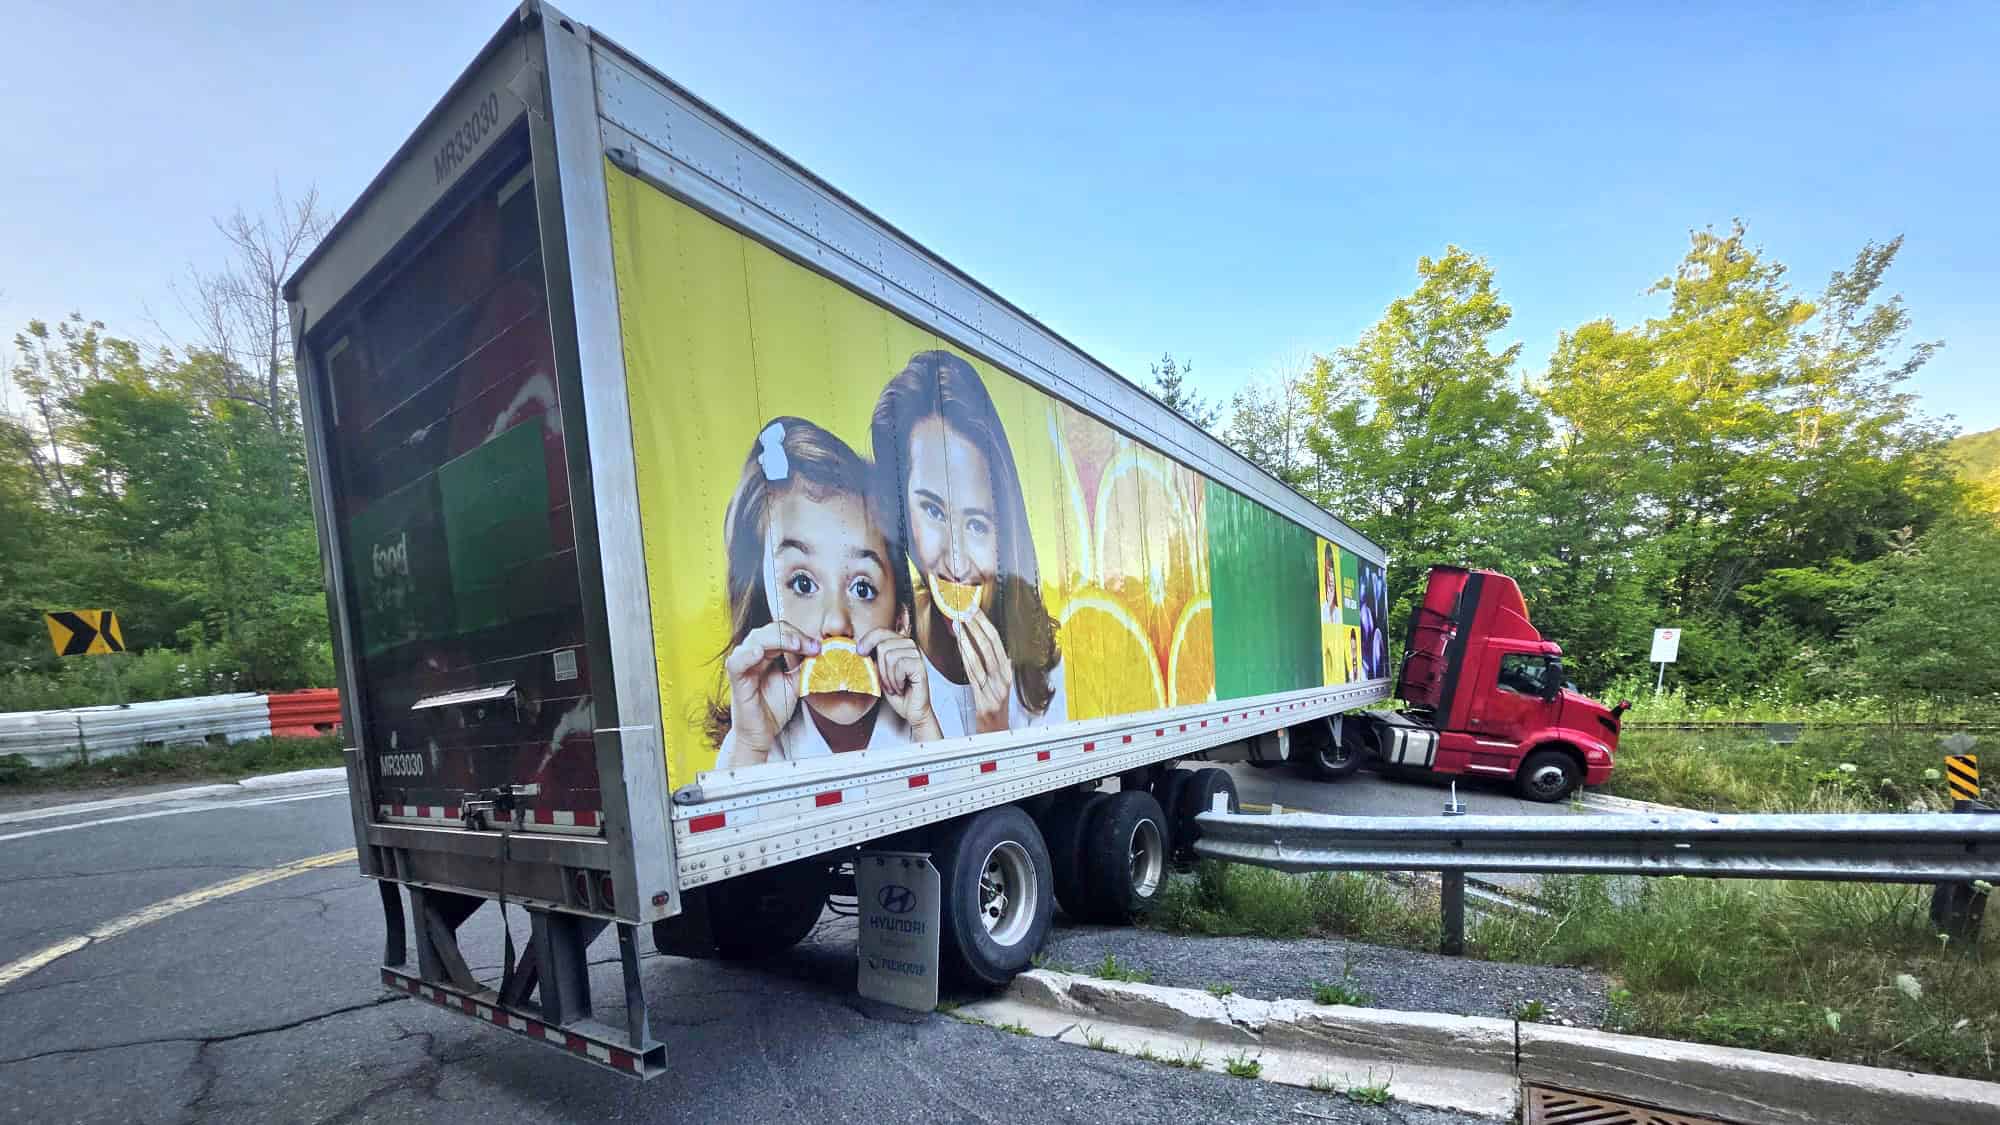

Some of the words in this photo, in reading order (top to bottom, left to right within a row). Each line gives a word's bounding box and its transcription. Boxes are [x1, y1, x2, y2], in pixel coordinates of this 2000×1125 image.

[433, 91, 498, 184] MR33030
[379, 753, 424, 777] MR33030
[870, 916, 925, 934] HYUNDAI
